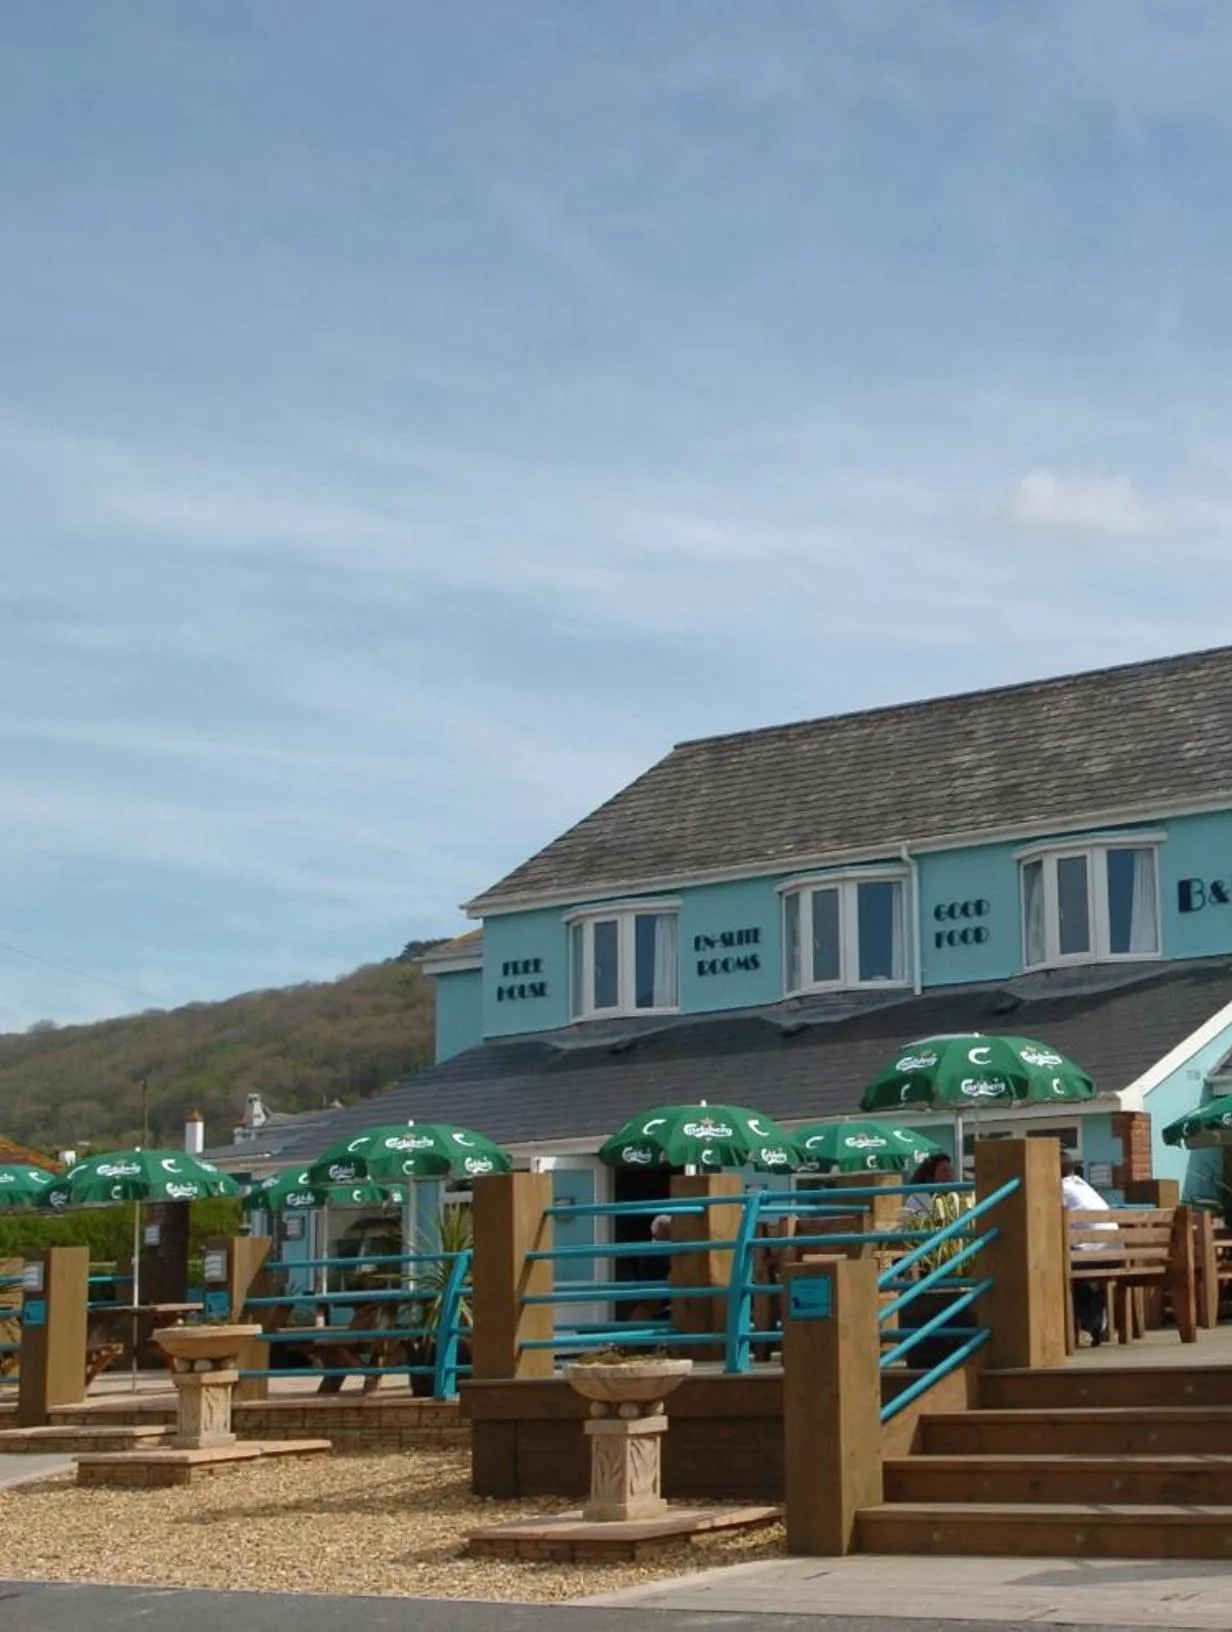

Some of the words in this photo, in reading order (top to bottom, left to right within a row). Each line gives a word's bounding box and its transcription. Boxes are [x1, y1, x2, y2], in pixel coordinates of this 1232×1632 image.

[934, 899, 990, 921] GOOD
[694, 927, 763, 951] EN-SUITE
[935, 926, 989, 949] FOOD
[502, 958, 543, 976] FREE
[697, 953, 760, 977] ROOMS
[497, 982, 548, 1001] HOUSE
[896, 1053, 938, 1071] Carlsberg
[961, 1078, 1006, 1097] Carlsberg
[683, 1122, 733, 1138] Carlsberg
[385, 1135, 434, 1149] Carlsberg
[845, 1135, 888, 1149] Carlsberg
